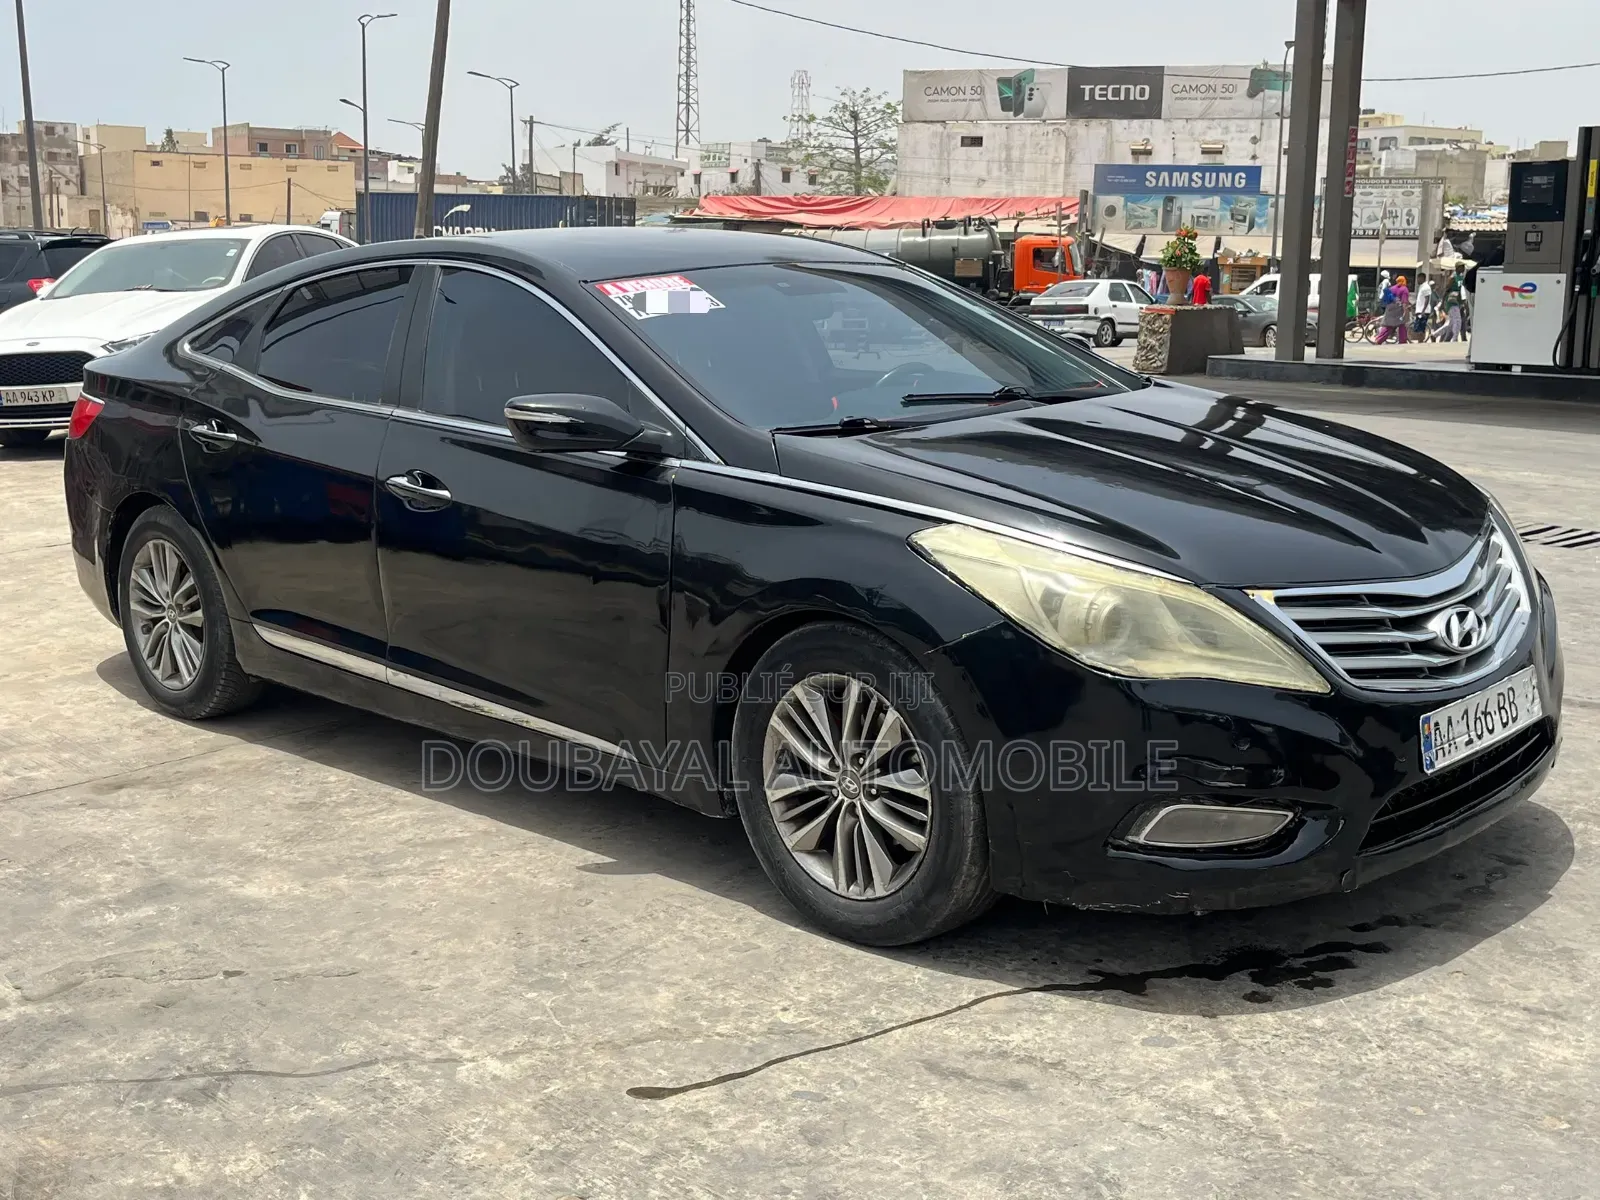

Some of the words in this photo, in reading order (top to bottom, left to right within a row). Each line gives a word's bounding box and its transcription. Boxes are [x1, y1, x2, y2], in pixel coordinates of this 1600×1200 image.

[924, 86, 966, 96] CAMON
[1080, 85, 1150, 101] TECNO
[1171, 83, 1217, 94] CAMON
[1145, 171, 1246, 188] SAMSUNG
[619, 275, 688, 292] VENDRE
[5, 392, 19, 403] AA
[20, 391, 40, 403] 943
[41, 390, 55, 402] KP
[1497, 686, 1519, 729] BB
